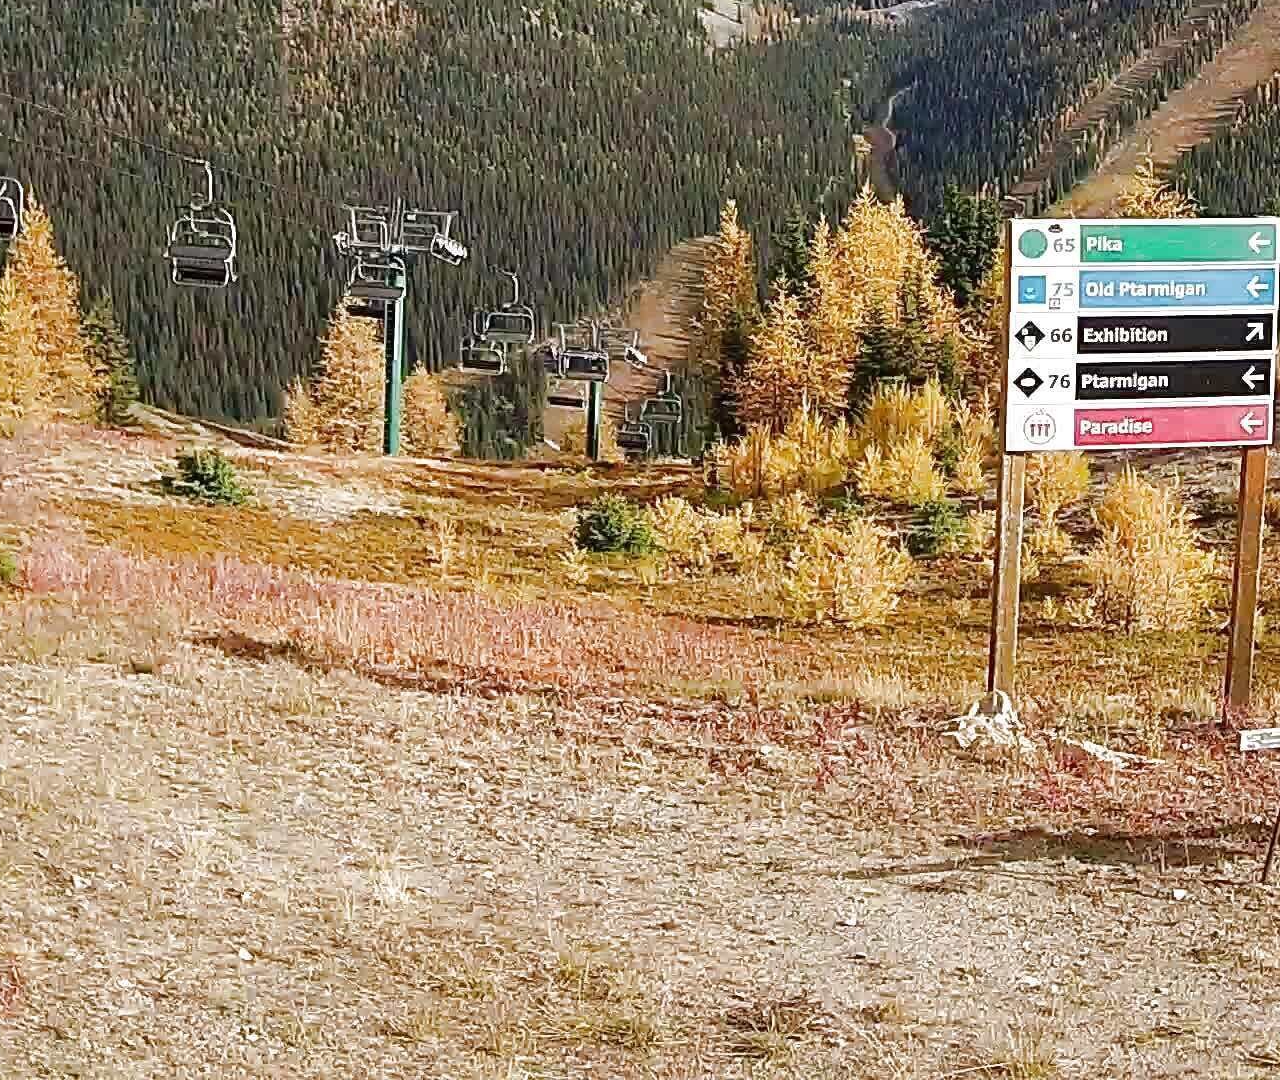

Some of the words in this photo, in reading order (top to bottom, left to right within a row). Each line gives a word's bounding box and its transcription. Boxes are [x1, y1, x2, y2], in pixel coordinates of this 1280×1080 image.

[1053, 238, 1076, 253] 65
[1086, 235, 1123, 252] Pika
[1051, 282, 1074, 297] 75
[1085, 281, 1114, 297] Old
[1119, 280, 1207, 299] Ptarmigan
[1050, 328, 1072, 343] 66
[1083, 327, 1168, 343] Exhibition
[1048, 374, 1071, 388] 76
[1081, 372, 1169, 391] Ptarmigan
[1080, 418, 1153, 435] Paradise
